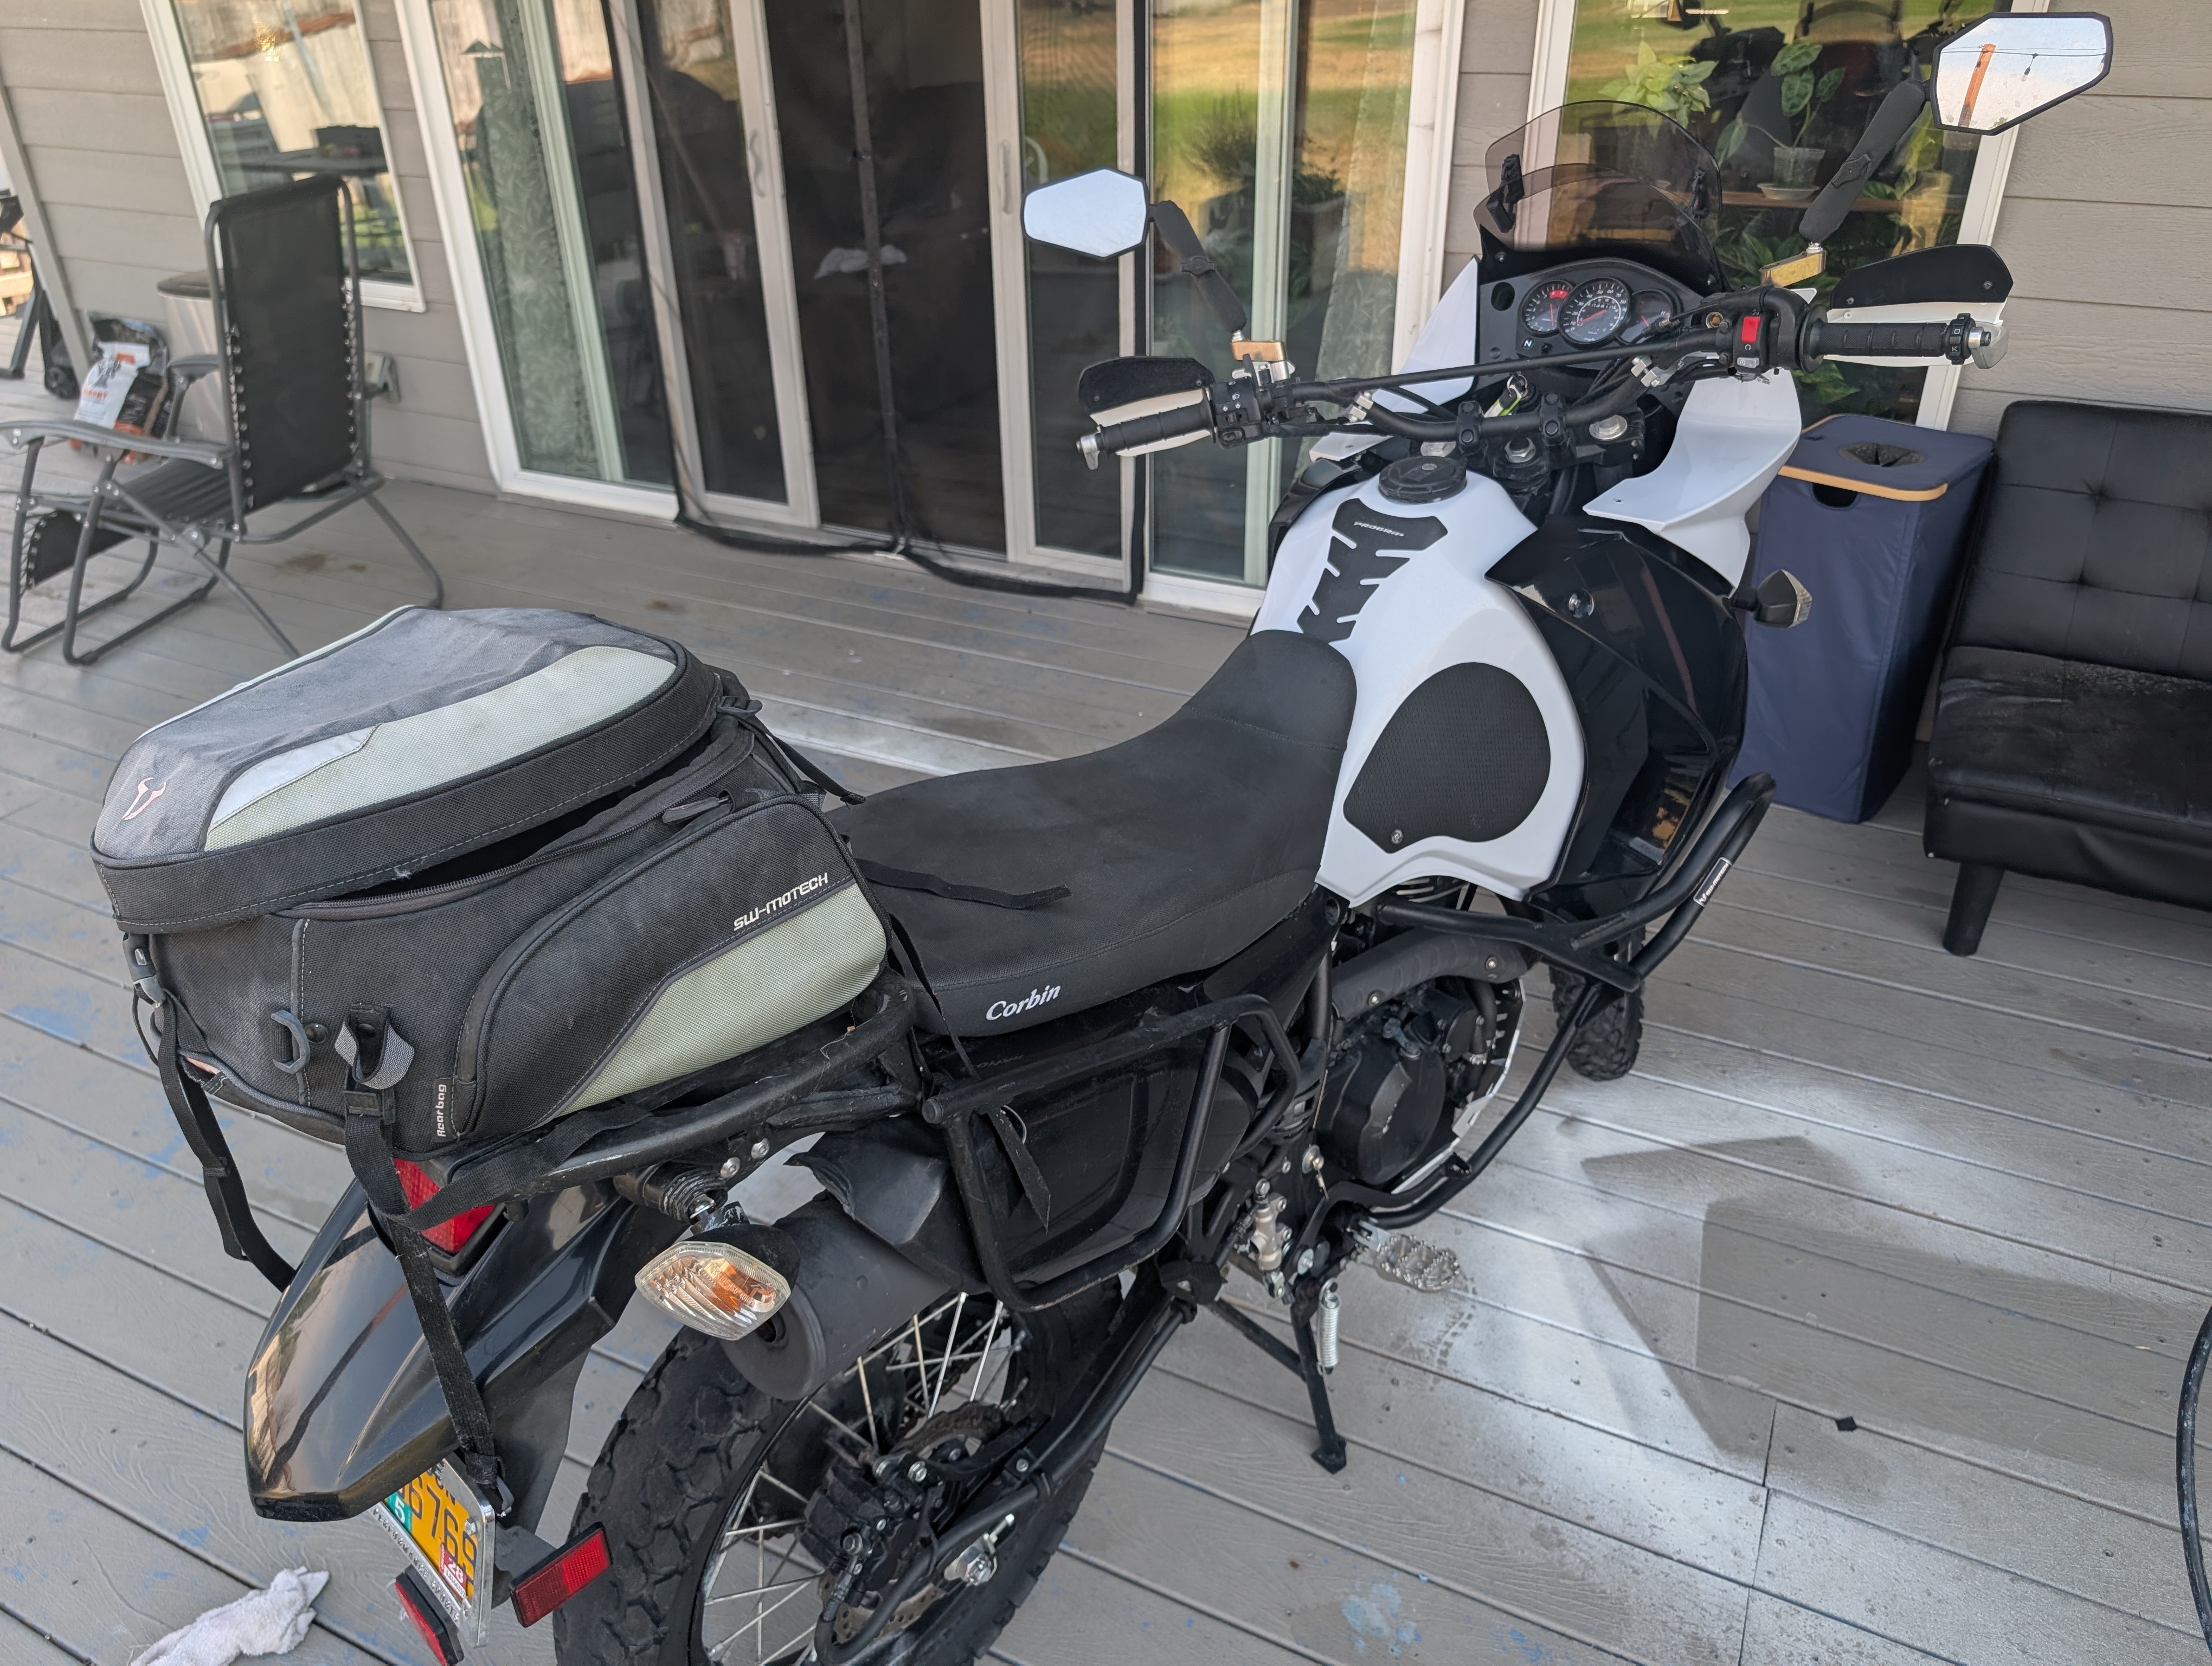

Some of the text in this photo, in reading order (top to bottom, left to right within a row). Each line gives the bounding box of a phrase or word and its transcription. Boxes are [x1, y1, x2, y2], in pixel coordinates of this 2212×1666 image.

[1353, 521, 1405, 537] PROGRIP
[734, 872, 828, 932] SW-MOTECH
[986, 983, 1061, 1021] Corbin
[435, 1084, 447, 1137] Rearbag
[394, 1495, 406, 1524] 5
[397, 1476, 477, 1586] 6769
